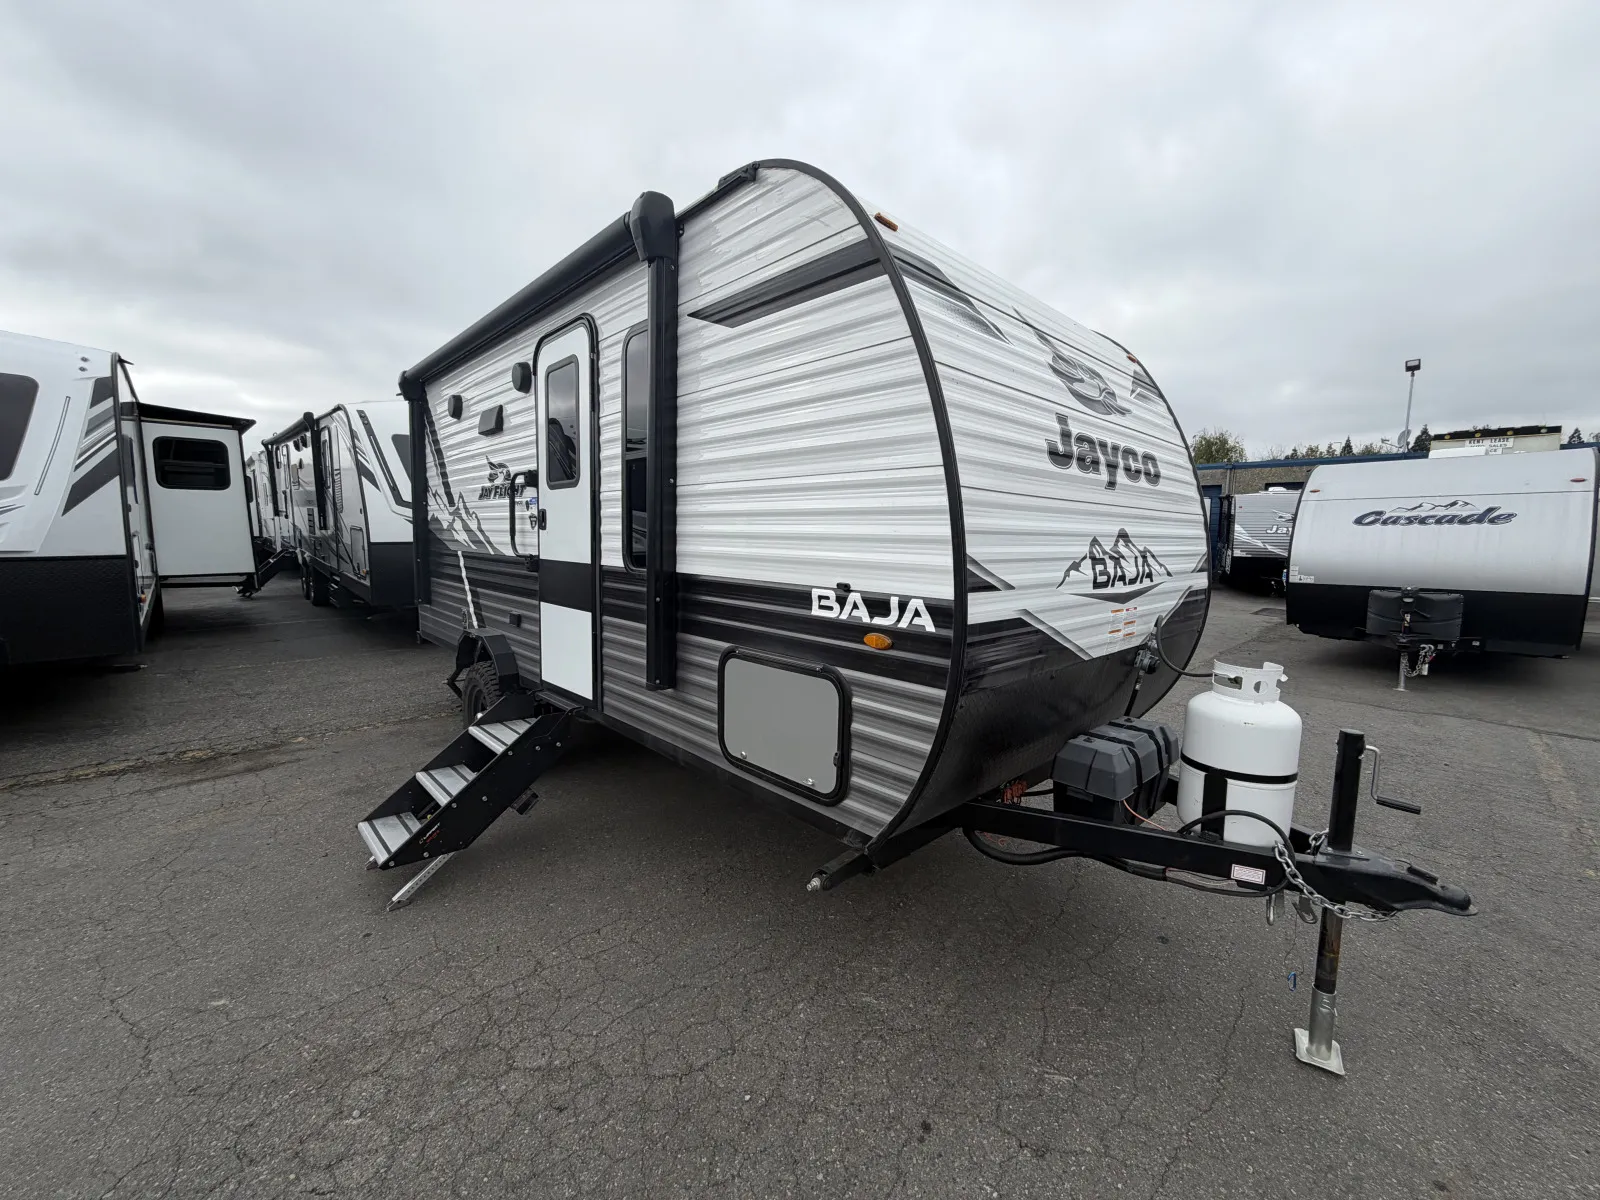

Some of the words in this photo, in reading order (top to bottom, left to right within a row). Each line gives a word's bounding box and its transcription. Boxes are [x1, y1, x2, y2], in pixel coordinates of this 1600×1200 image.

[1045, 412, 1161, 491] Jayco
[478, 485, 494, 501] JAY
[1352, 506, 1517, 527] Cascade
[1090, 550, 1154, 590] BAJA
[811, 588, 936, 633] BAJA
